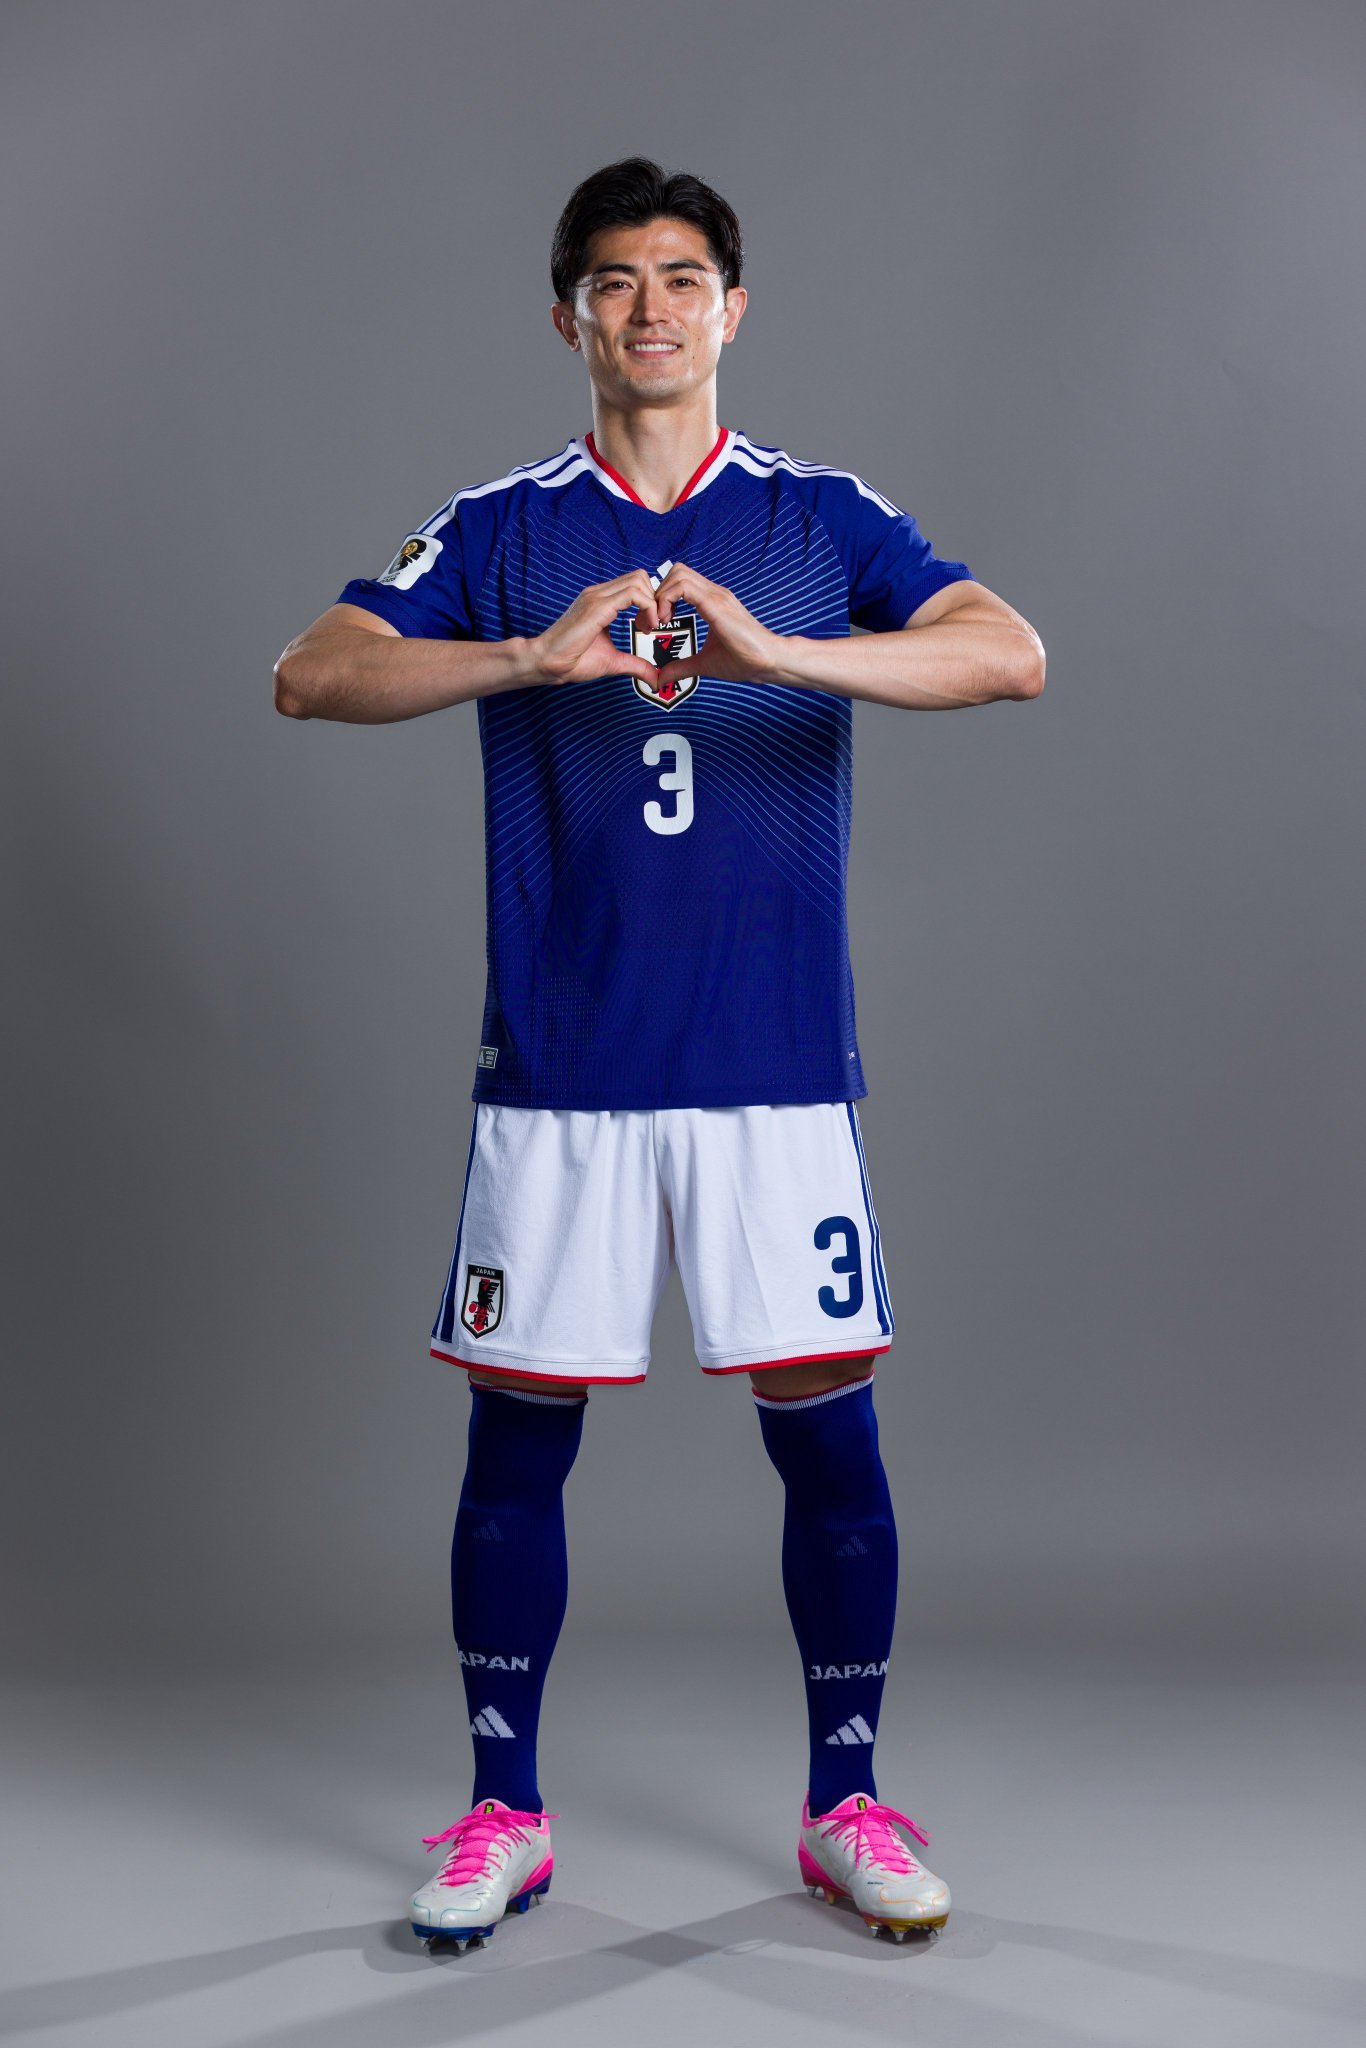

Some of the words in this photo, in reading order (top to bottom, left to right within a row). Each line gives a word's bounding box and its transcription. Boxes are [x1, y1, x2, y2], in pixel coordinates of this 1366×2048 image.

[652, 620, 681, 630] PAN
[642, 733, 694, 835] 3
[476, 1268, 496, 1277] JAPAN
[813, 1216, 863, 1318] 3
[469, 1313, 489, 1328] JFA
[457, 1648, 530, 1671] APAN
